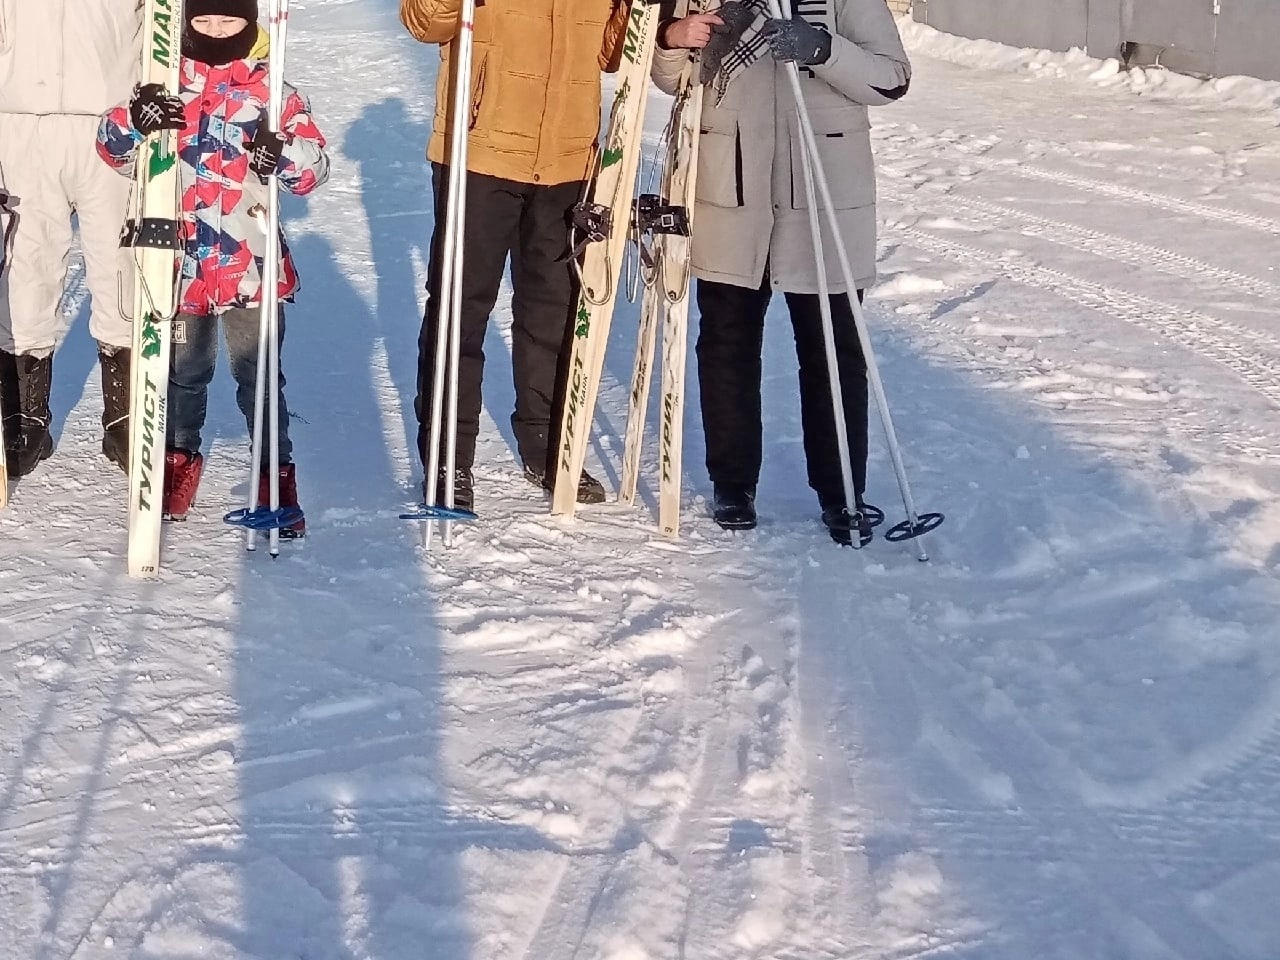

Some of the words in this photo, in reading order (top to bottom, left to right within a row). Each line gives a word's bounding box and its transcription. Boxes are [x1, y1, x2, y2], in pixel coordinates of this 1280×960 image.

[139, 371, 157, 512] ТУРИСТ
[158, 395, 166, 433] МАЯК
[562, 349, 583, 473] ТУРИСТ
[663, 392, 673, 483] ТУРИ
